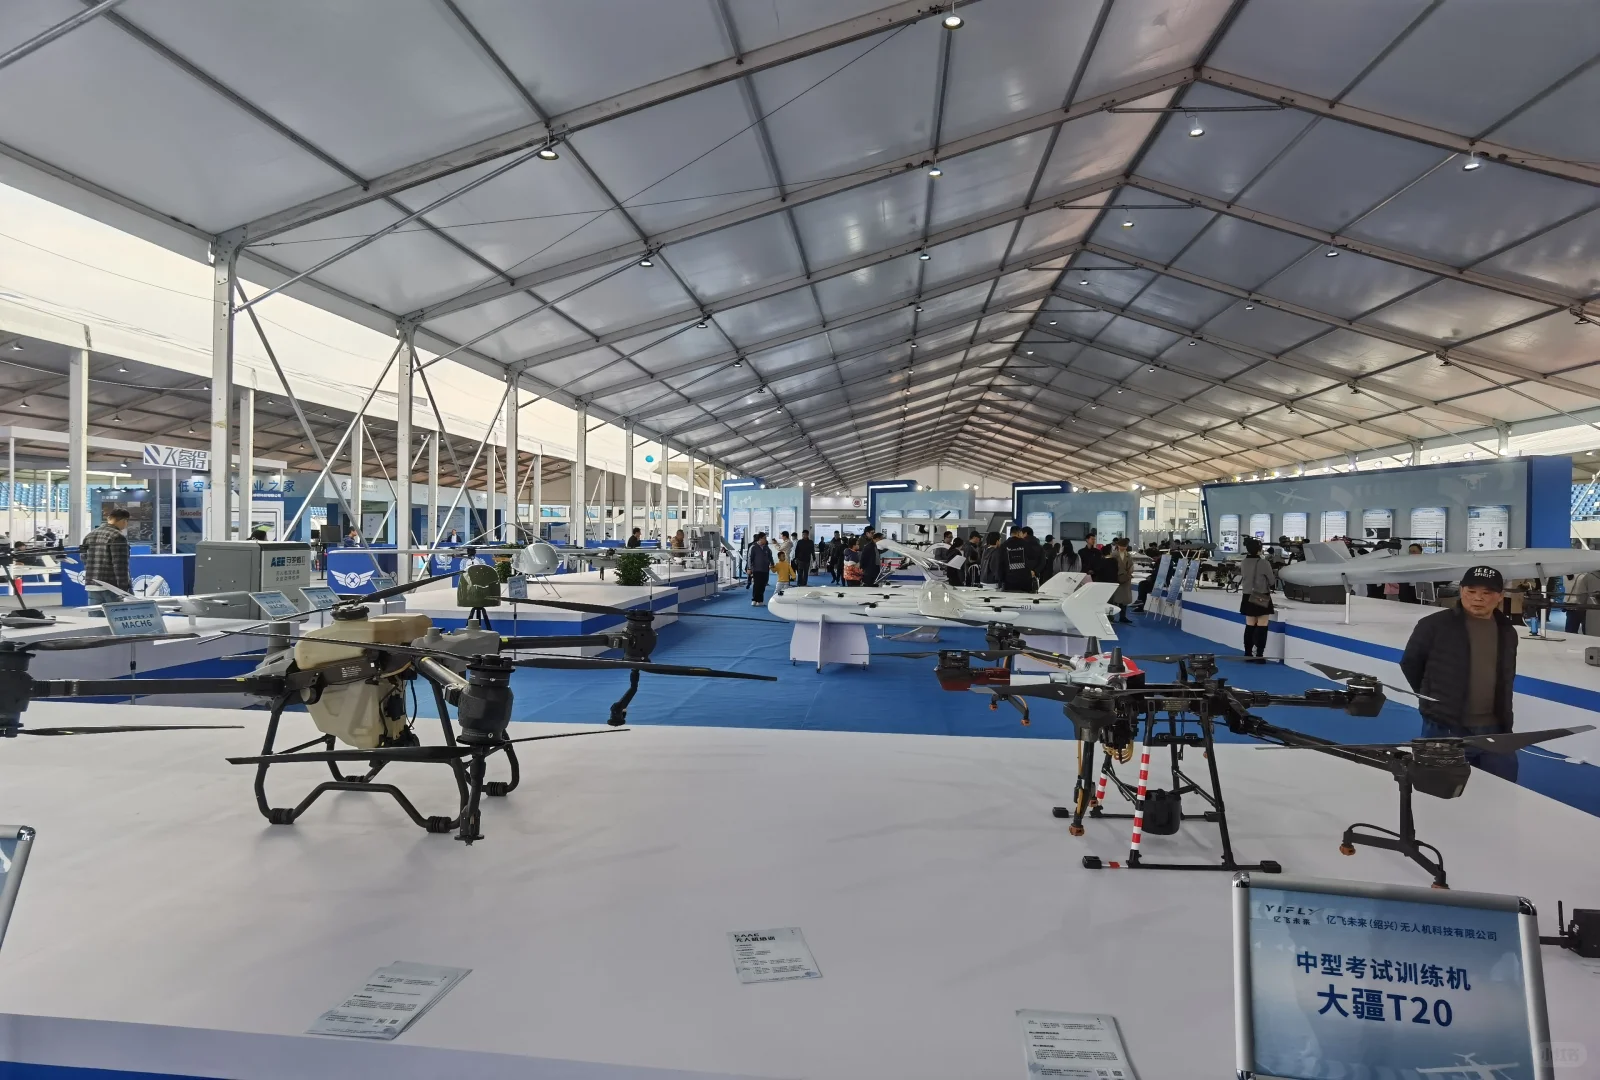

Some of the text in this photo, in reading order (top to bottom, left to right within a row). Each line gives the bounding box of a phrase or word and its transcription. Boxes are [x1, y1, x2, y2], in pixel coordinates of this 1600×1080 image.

[122, 619, 153, 629] MACH6
[1265, 904, 1324, 916] YIFLY
[1273, 916, 1311, 926] 亿飞未来
[1296, 950, 1472, 991] 中型考试训练机
[1317, 984, 1453, 1028] 大疆T20
